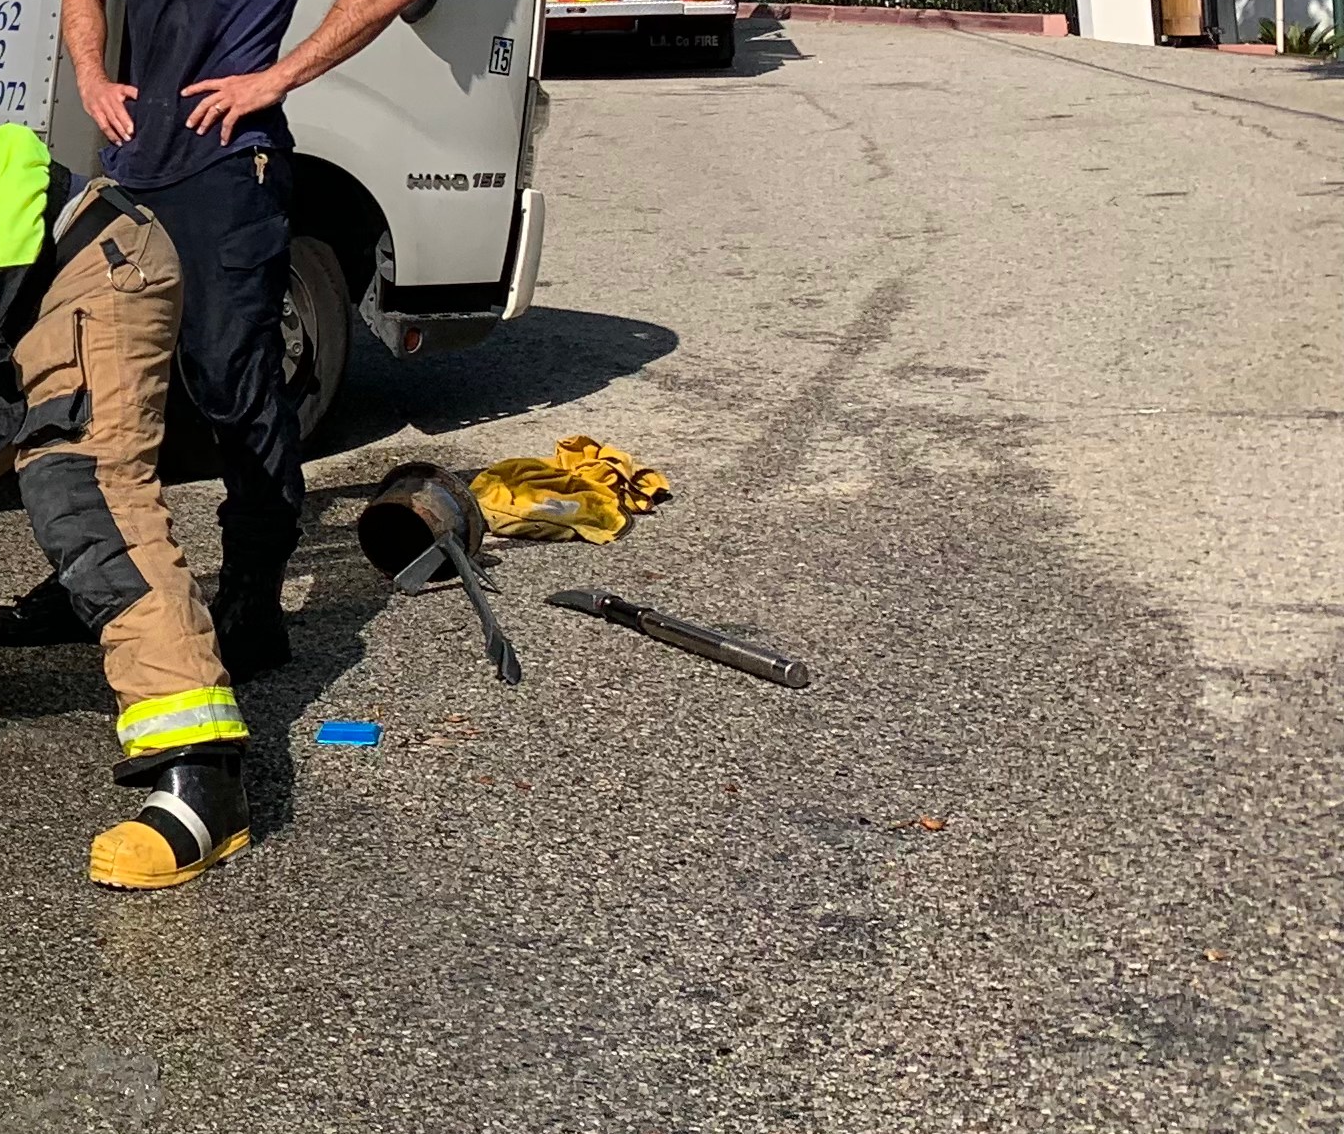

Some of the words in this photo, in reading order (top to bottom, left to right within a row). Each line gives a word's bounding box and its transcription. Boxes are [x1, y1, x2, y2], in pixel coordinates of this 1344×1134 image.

[694, 35, 719, 47] FIRE
[494, 47, 511, 72] 15
[407, 173, 470, 192] HINO
[472, 172, 507, 188] 155
